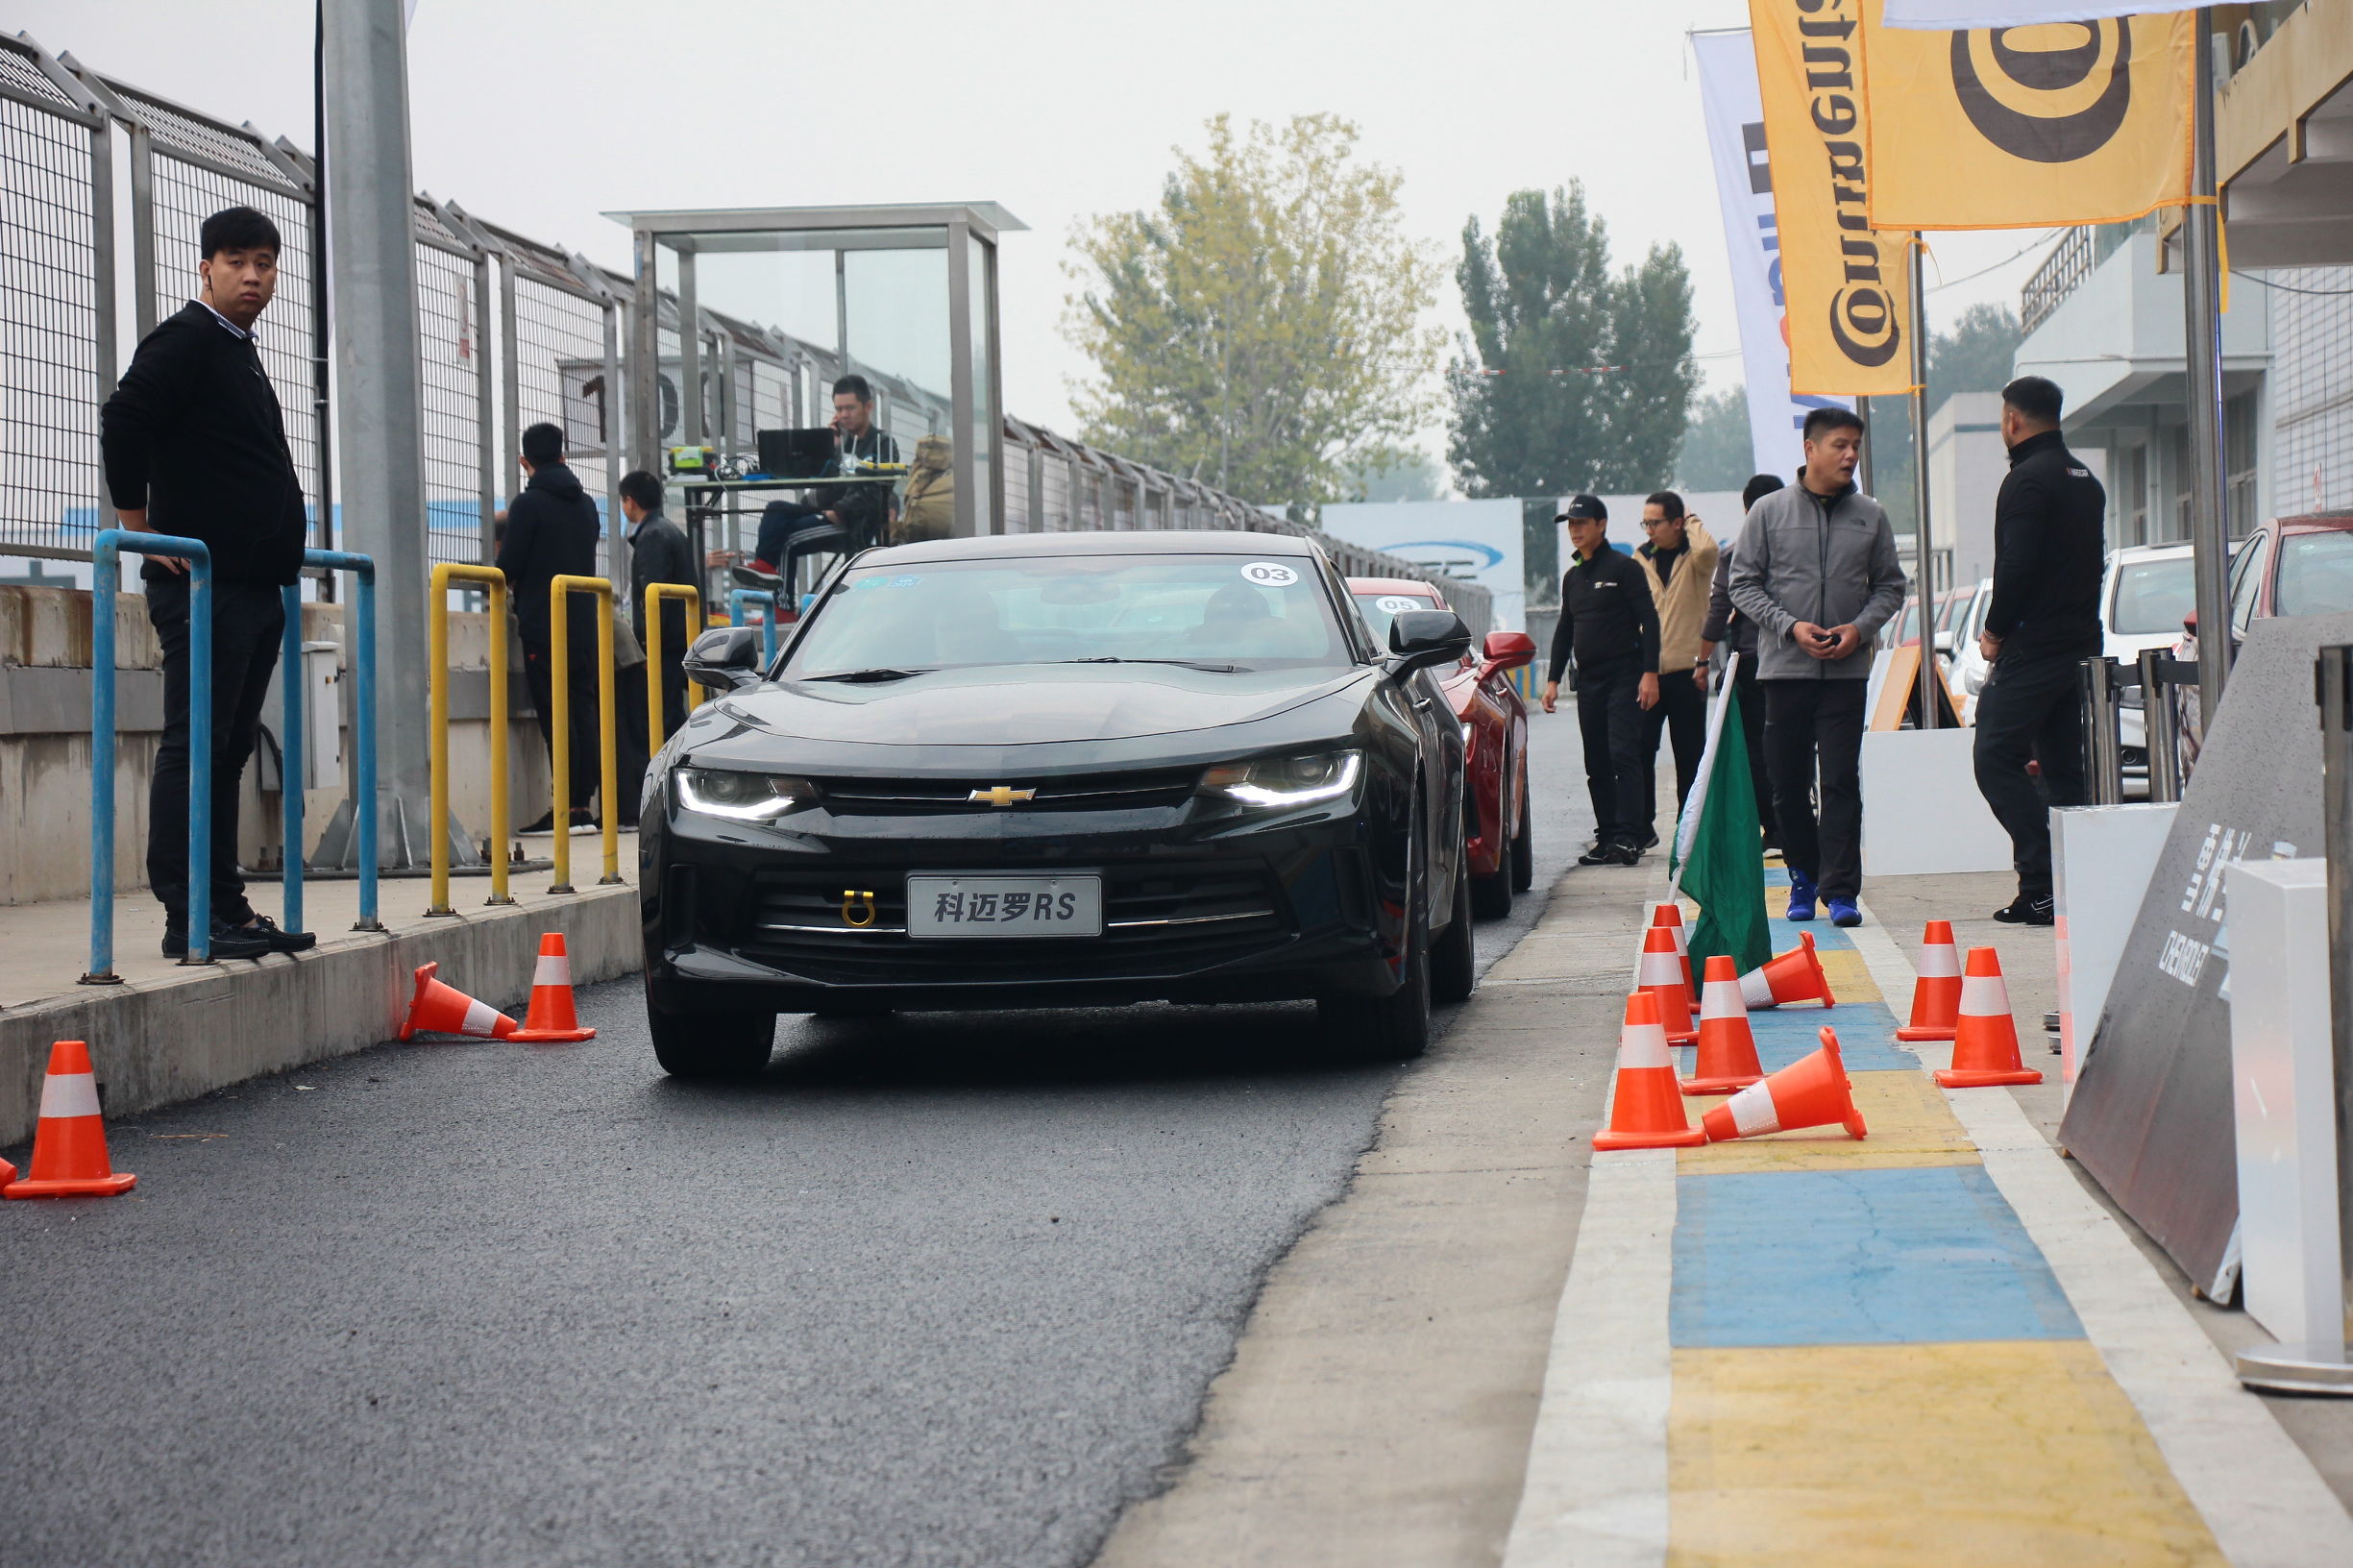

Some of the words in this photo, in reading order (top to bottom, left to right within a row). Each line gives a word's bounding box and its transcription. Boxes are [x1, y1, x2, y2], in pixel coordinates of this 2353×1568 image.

[1250, 567, 1290, 581] 03
[1384, 599, 1413, 610] 05
[934, 892, 1076, 922] 科迈罗RS
